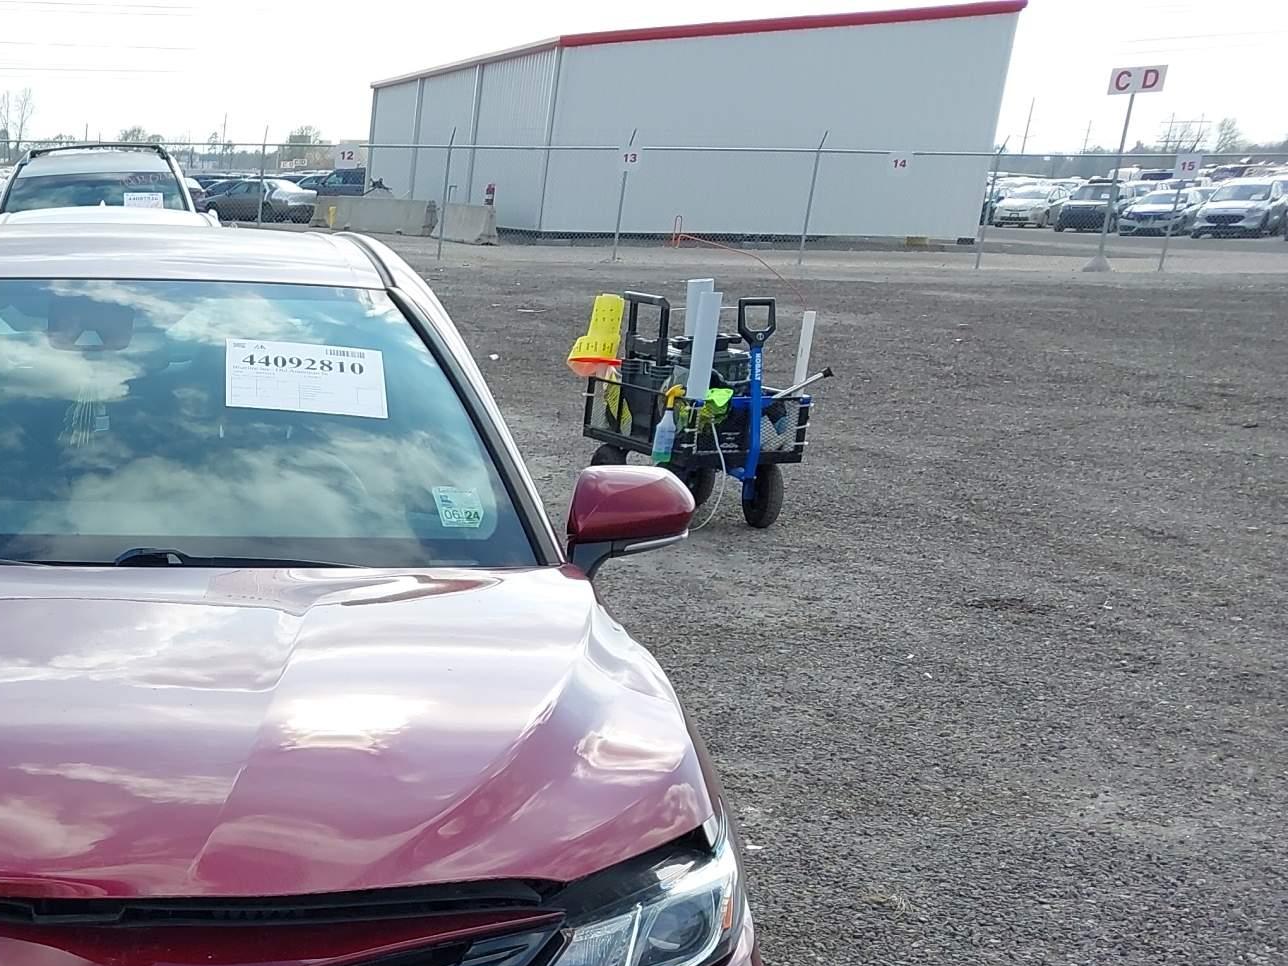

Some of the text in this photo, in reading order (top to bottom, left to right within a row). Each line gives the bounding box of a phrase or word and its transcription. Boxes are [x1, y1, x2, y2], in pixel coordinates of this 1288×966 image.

[1115, 69, 1160, 91] C D
[340, 150, 354, 161] 12
[623, 153, 637, 163] 13
[893, 159, 907, 169] 14
[1181, 161, 1196, 171] 15
[241, 353, 365, 376] 44092810
[754, 352, 762, 381] KOBALT
[444, 509, 460, 520] 06
